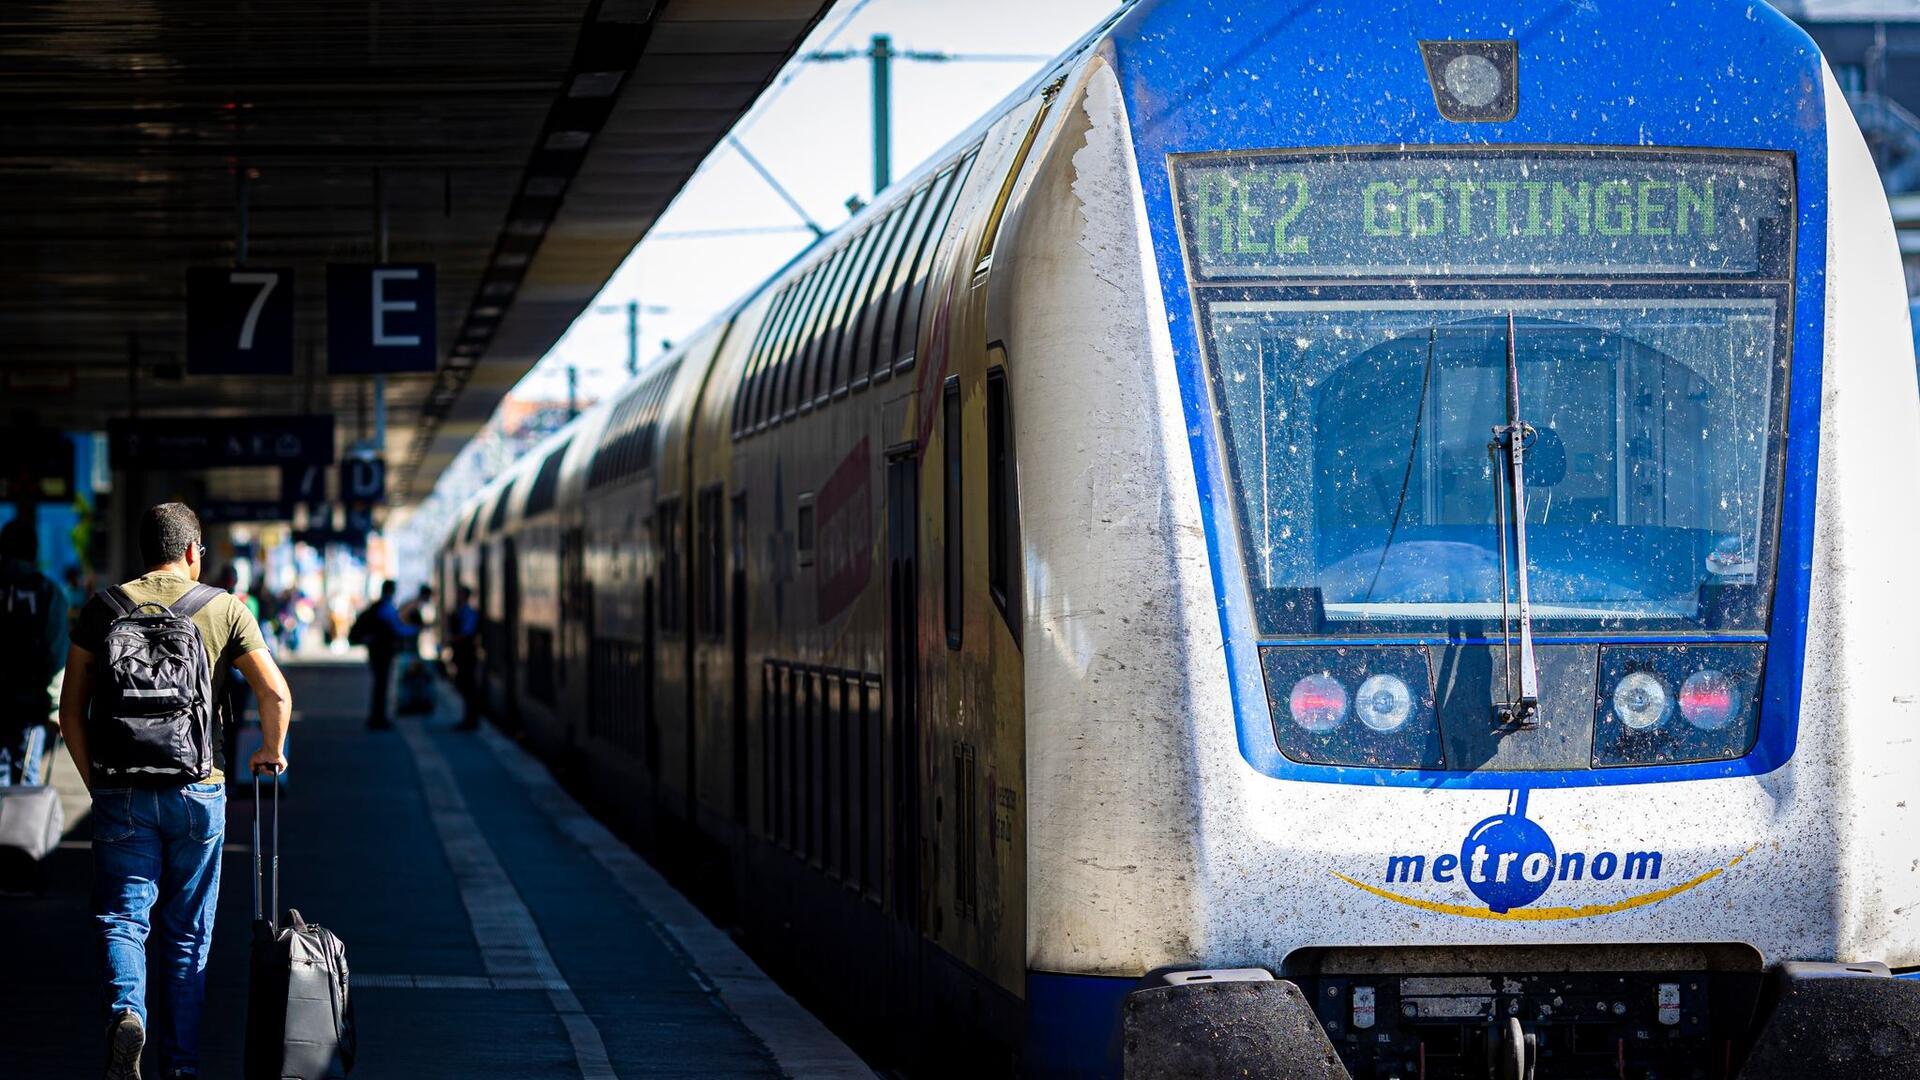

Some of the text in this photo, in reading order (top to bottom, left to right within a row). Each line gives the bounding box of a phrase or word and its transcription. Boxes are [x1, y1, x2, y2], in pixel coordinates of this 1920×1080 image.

[1198, 170, 1717, 254] RE2 GÖTTINGEN
[229, 271, 280, 351] 7
[371, 268, 422, 348] E
[351, 462, 384, 496] D
[1385, 843, 1663, 885] metronom
